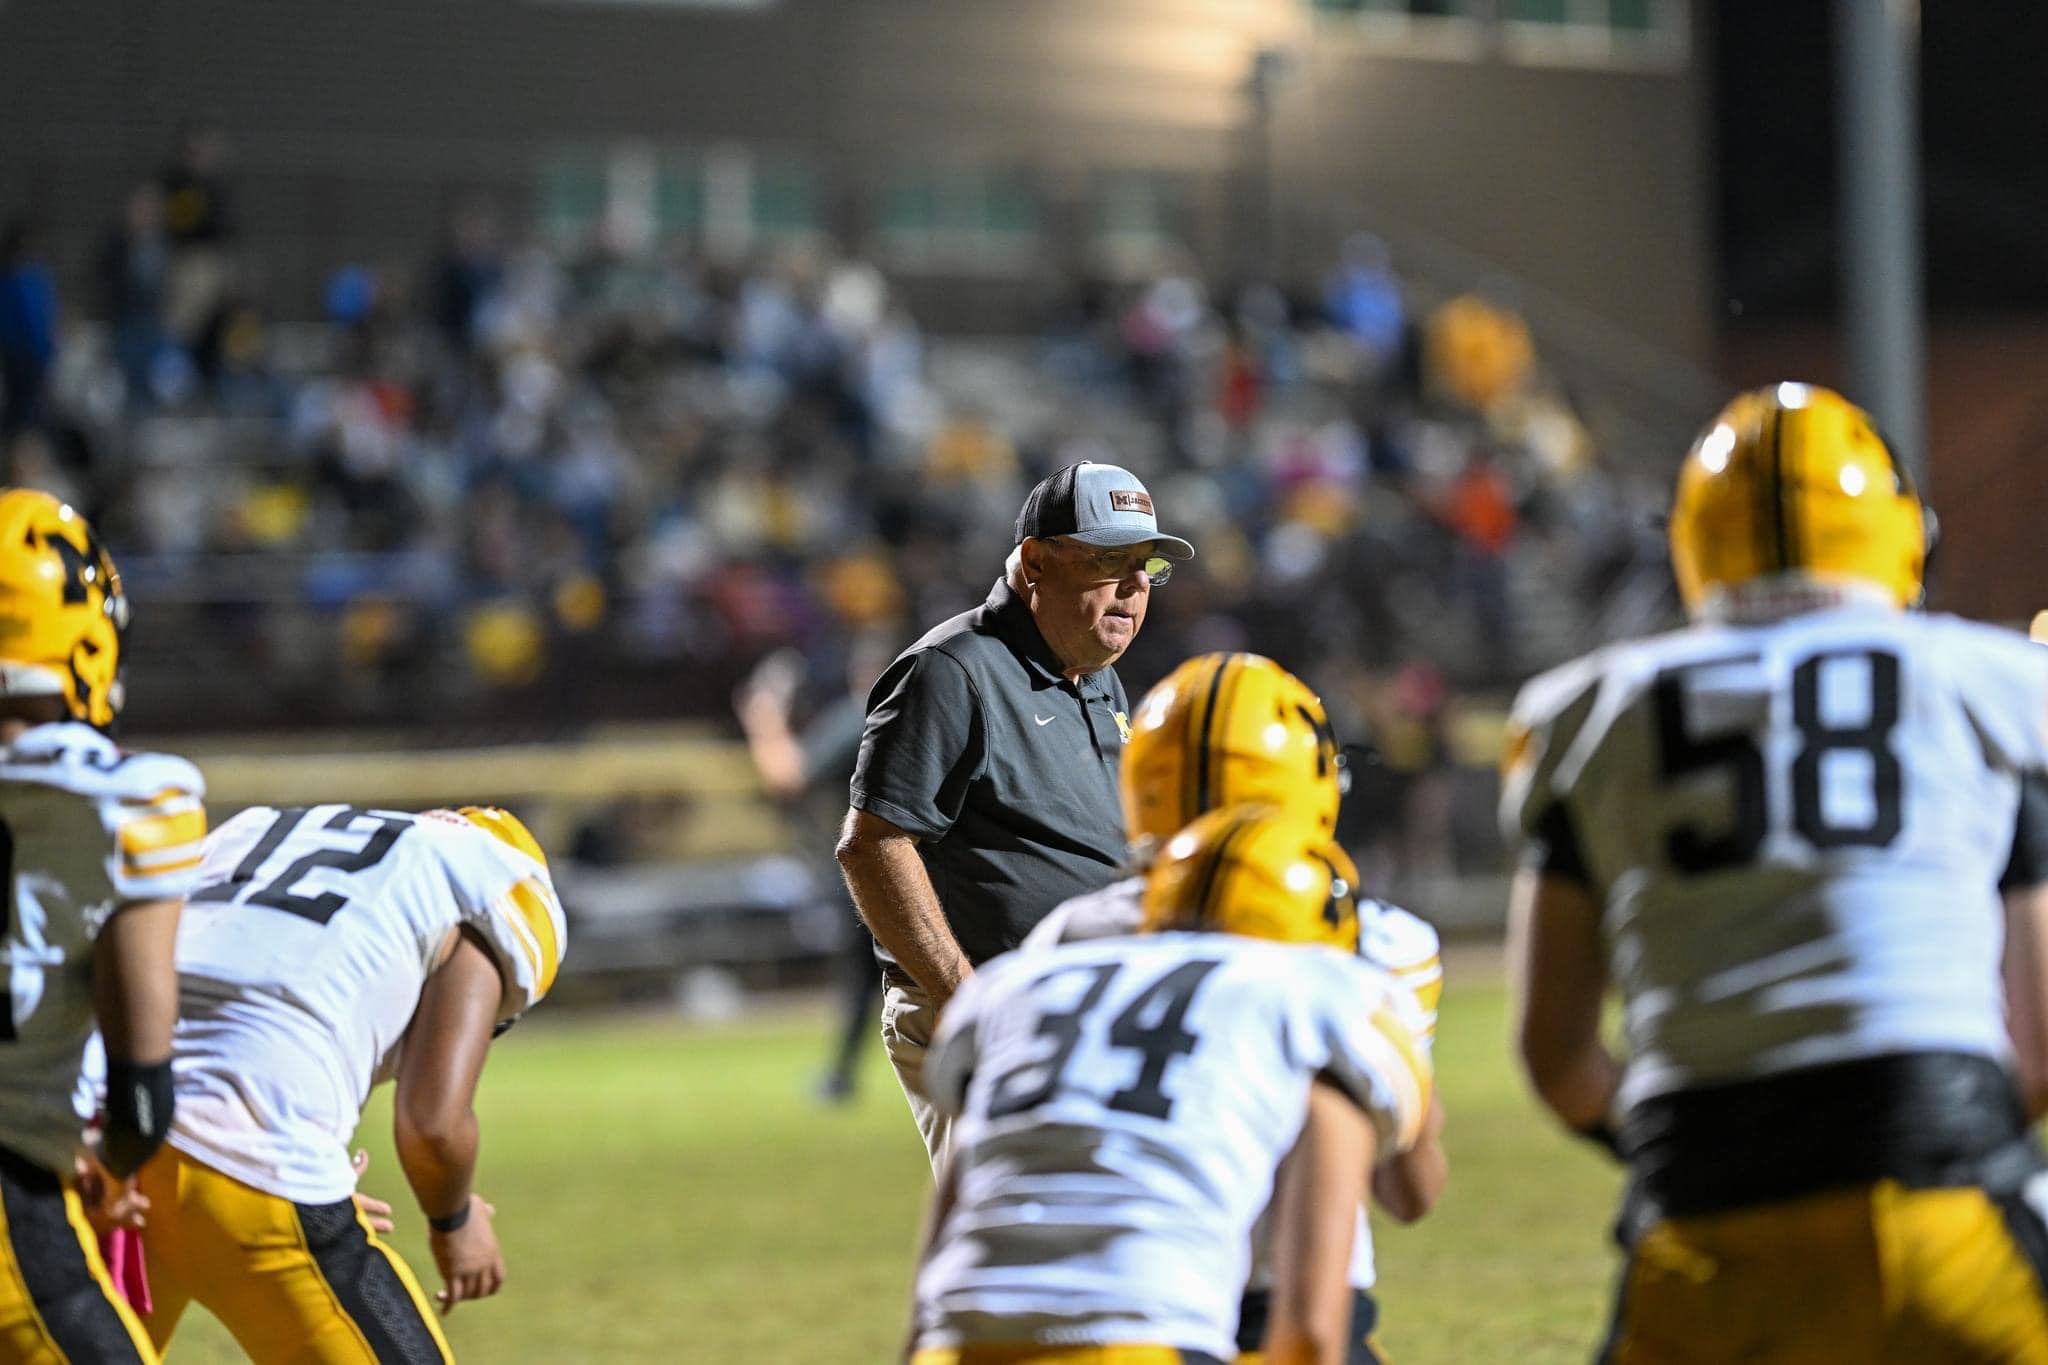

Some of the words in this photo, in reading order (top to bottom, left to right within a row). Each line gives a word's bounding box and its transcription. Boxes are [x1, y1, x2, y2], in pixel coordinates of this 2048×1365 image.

[1115, 495, 1128, 505] M
[1653, 648, 1905, 878] 58
[188, 808, 416, 926] 12
[986, 960, 1223, 1121] 34
